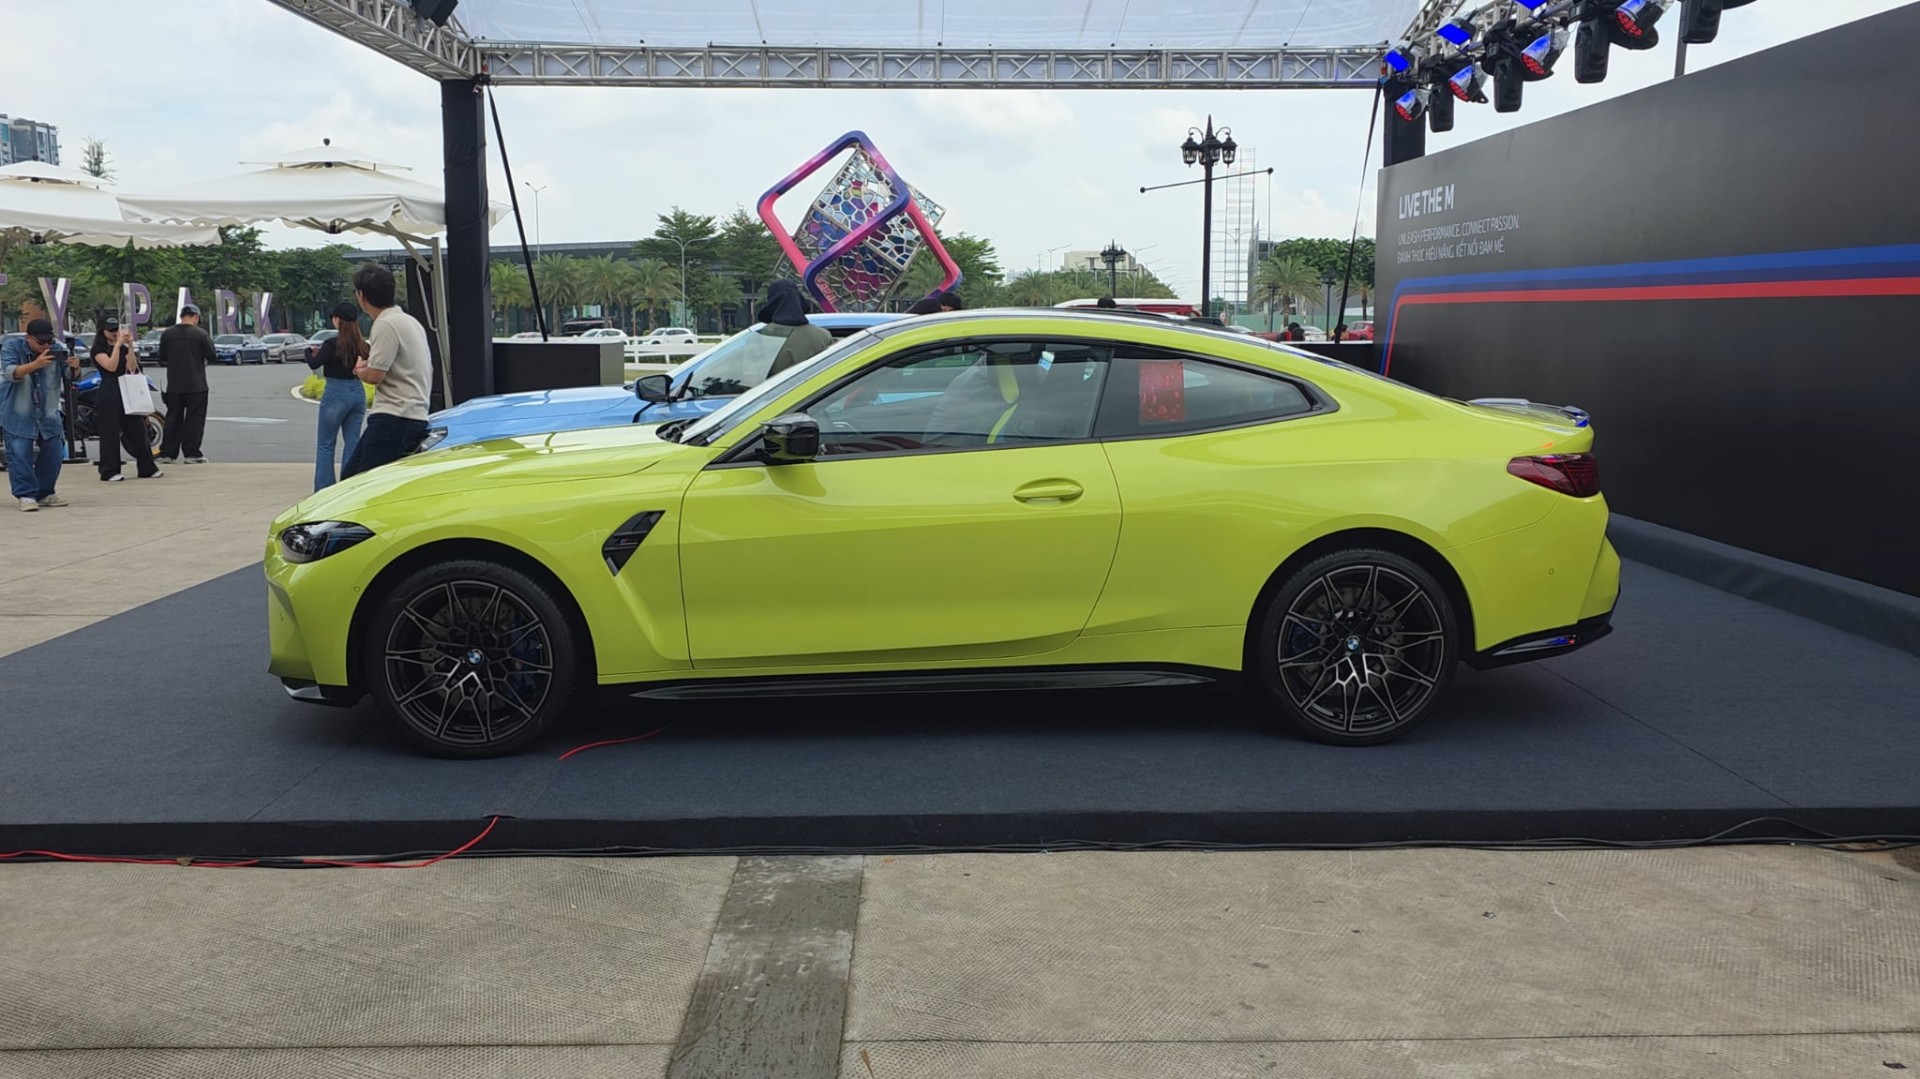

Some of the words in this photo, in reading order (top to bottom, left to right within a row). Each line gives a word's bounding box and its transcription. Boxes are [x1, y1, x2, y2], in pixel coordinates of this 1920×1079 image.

[1399, 192, 1420, 219] LIVE
[1422, 186, 1443, 215] THE
[1445, 183, 1455, 211] M
[1461, 218, 1490, 237] CONNECT
